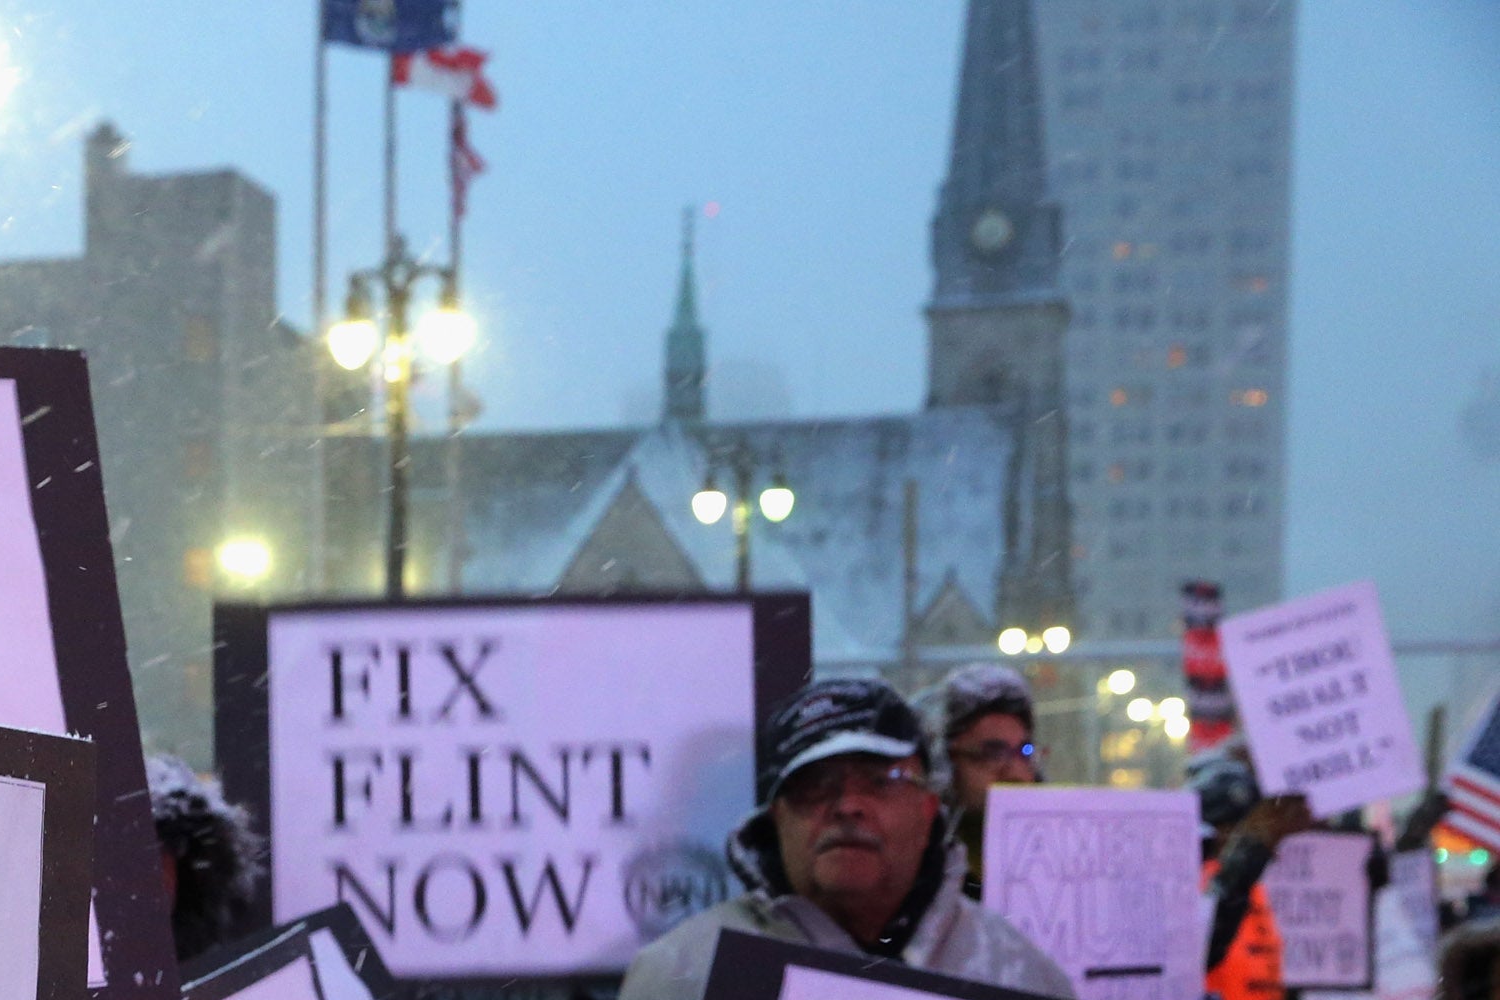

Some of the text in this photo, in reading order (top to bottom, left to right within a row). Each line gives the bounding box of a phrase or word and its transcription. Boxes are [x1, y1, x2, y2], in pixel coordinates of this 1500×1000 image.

[319, 636, 503, 725] FIX
[324, 743, 652, 834] FLINT
[324, 852, 599, 945] NOW
